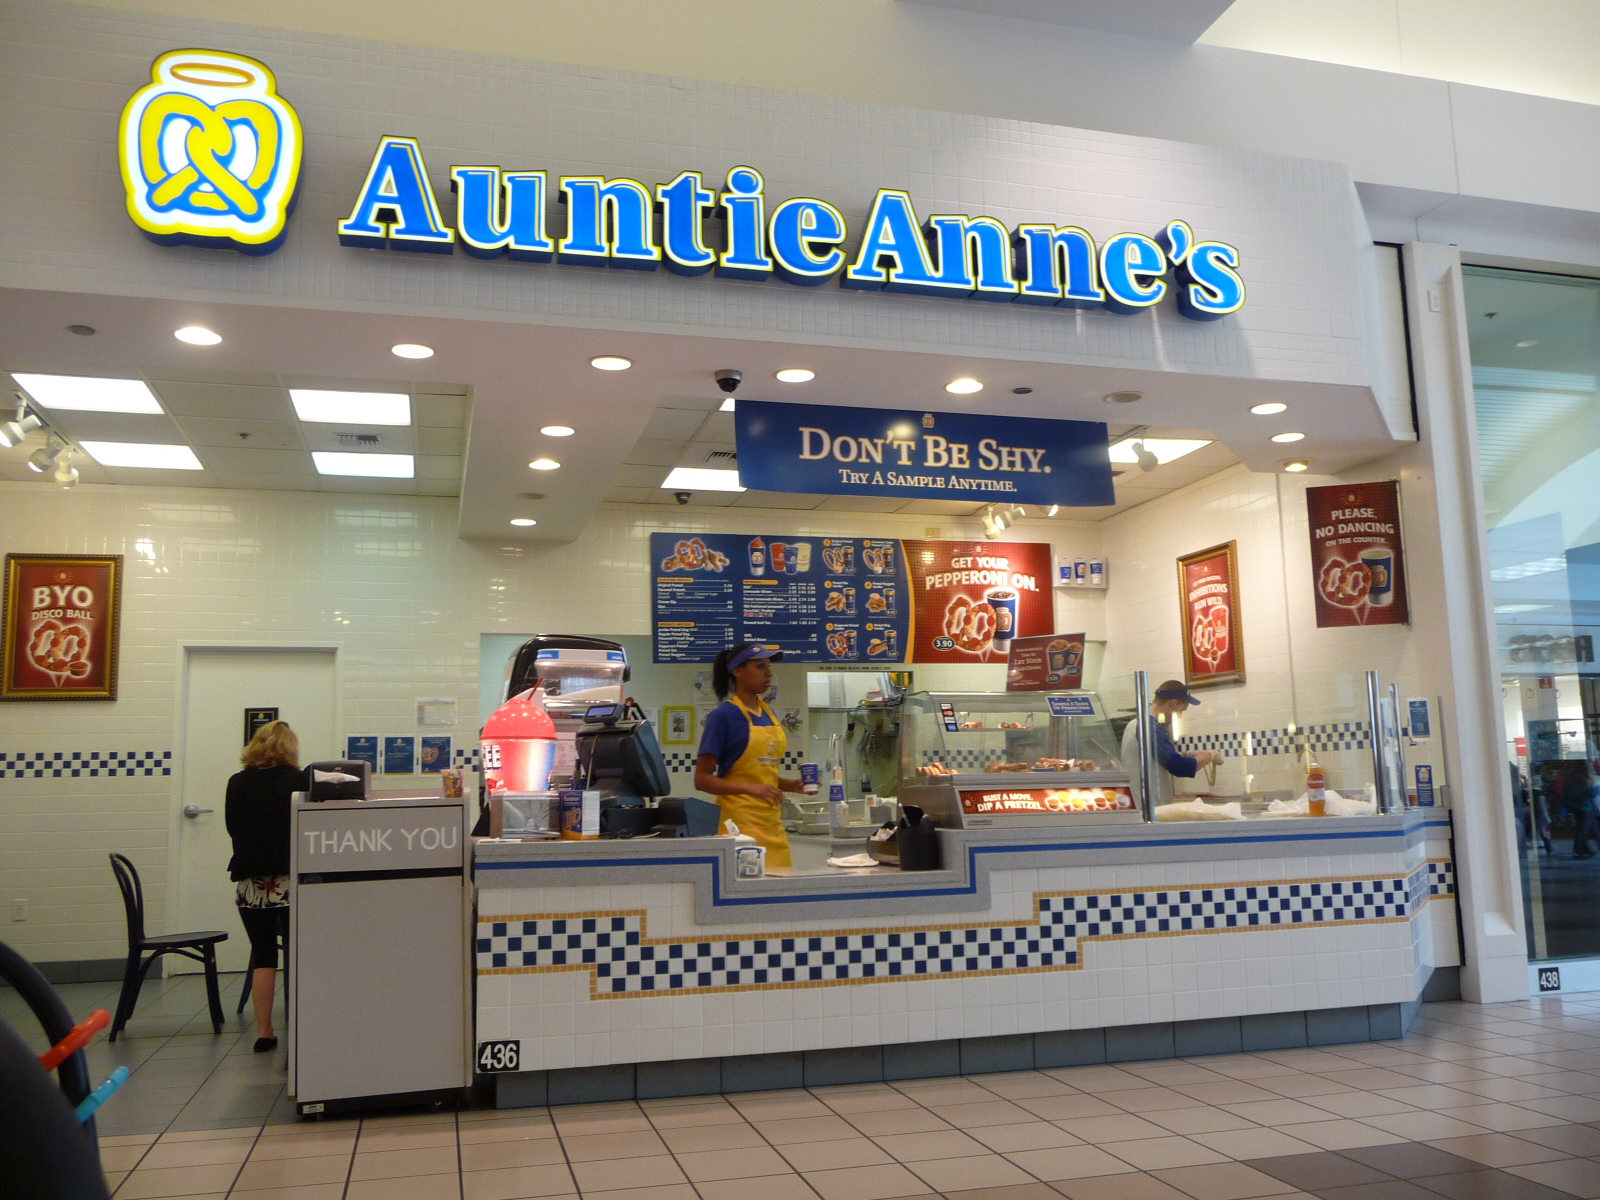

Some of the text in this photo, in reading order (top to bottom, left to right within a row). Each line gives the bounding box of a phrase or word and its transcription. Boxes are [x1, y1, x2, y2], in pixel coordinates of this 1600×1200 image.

[923, 435, 971, 469] BE
[978, 438, 1052, 474] SHY.
[839, 469, 1018, 492] TRY A SAMPLE ANYTIME.
[1315, 522, 1394, 539] NO DANCING
[1337, 537, 1352, 545] THE
[952, 556, 1010, 570] GET YOUR
[926, 570, 1040, 592] PEPPERONI ON.
[33, 584, 94, 608] BYO
[32, 609, 63, 620] DISCO
[977, 802, 992, 811] DIP
[995, 801, 1003, 810] A
[304, 826, 457, 854] THANK YOU
[1540, 971, 1559, 988] 438
[480, 1043, 517, 1069] 436
